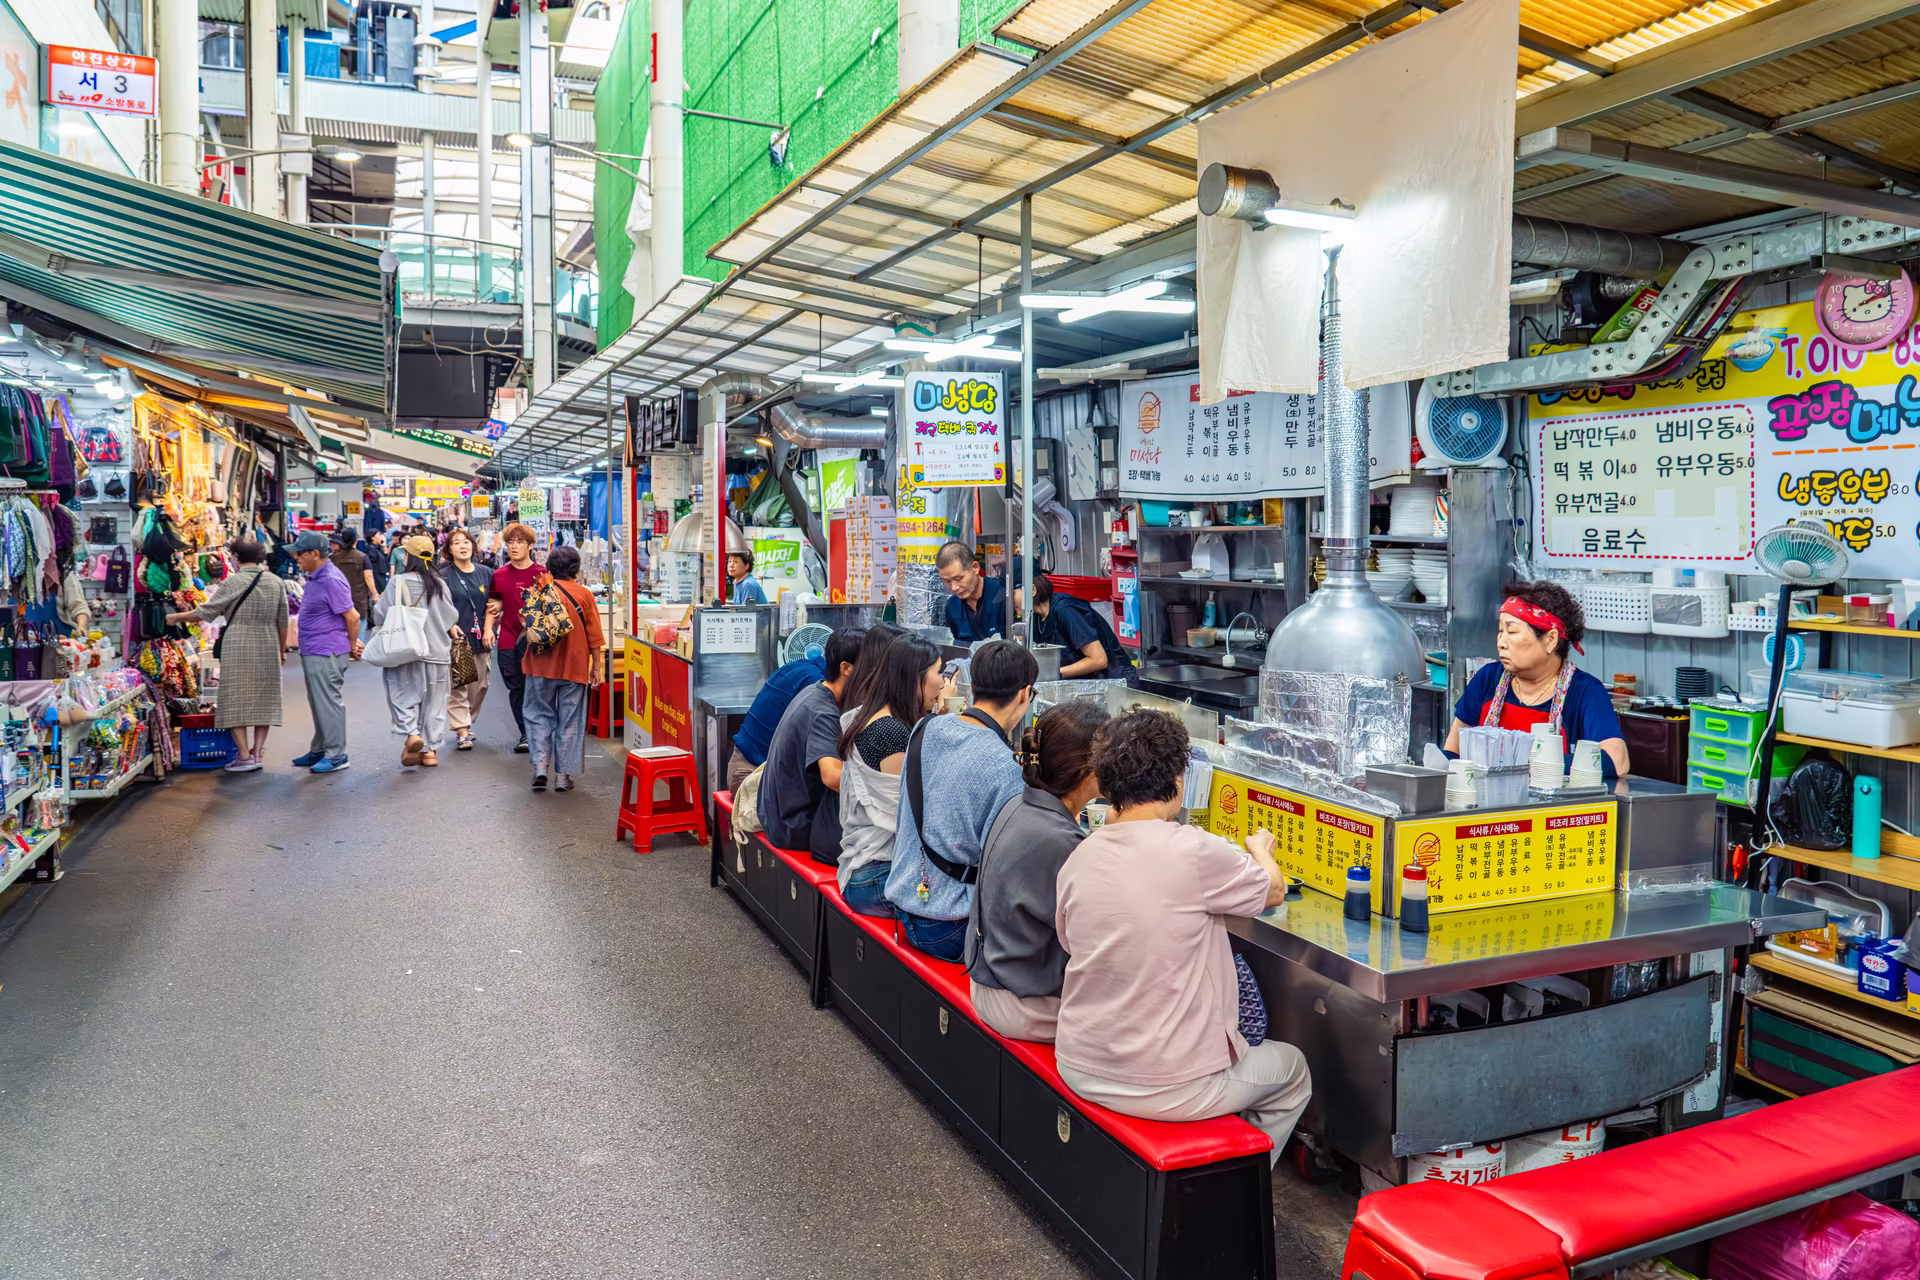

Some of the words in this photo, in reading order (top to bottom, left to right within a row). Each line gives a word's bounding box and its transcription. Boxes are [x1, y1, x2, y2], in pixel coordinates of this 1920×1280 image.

[71, 50, 137, 69] 아진상가
[78, 72, 97, 91] 서
[113, 75, 128, 93] 3
[104, 97, 146, 110] 소방통로
[1831, 285, 1842, 294] 10
[1825, 304, 1832, 312] 9
[1833, 321, 1839, 330] 8
[1886, 325, 1893, 334] 5
[1847, 332, 1854, 340] 7
[914, 379, 998, 414] 미성당
[1227, 403, 1239, 456] 냄비우동
[1656, 416, 1735, 444] 냄비우동
[1735, 423, 1754, 434] 4.0
[1553, 426, 1619, 450] 납작만두
[1619, 429, 1636, 441] 4.0
[1283, 467, 1296, 477] 5.0
[1305, 465, 1316, 475] 8.0
[1620, 463, 1637, 475] 4.0
[1656, 452, 1736, 478] 유부우동
[1736, 457, 1755, 469] 5.0
[1184, 474, 1194, 483] 4.0
[1227, 473, 1239, 482] 4.0
[1778, 468, 1891, 506] 냉동유부
[1890, 483, 1910, 495] 8.0
[520, 505, 544, 515] 잔치국수
[1555, 492, 1619, 514] 유부전골
[1619, 496, 1636, 507] 4.0
[1875, 526, 1896, 538] 5.0
[1582, 528, 1647, 554] 음료수
[1319, 812, 1336, 825] 비조리
[1336, 817, 1370, 836] 포장(밀키트)
[1549, 817, 1569, 828] 비조리
[1569, 814, 1604, 826] 포장(밀키트)
[1469, 826, 1489, 836] 식사류
[1494, 823, 1520, 834] 식사메뉴
[1496, 839, 1505, 878] 냄비우동
[1510, 838, 1518, 876] 유부우동
[1523, 837, 1531, 874] 음료수
[1558, 833, 1566, 870] 유부전골
[1455, 844, 1464, 882] 납작만두
[1483, 841, 1491, 879] 유부전골
[1597, 875, 1605, 883] 5.0
[1521, 885, 1530, 893] 2.0
